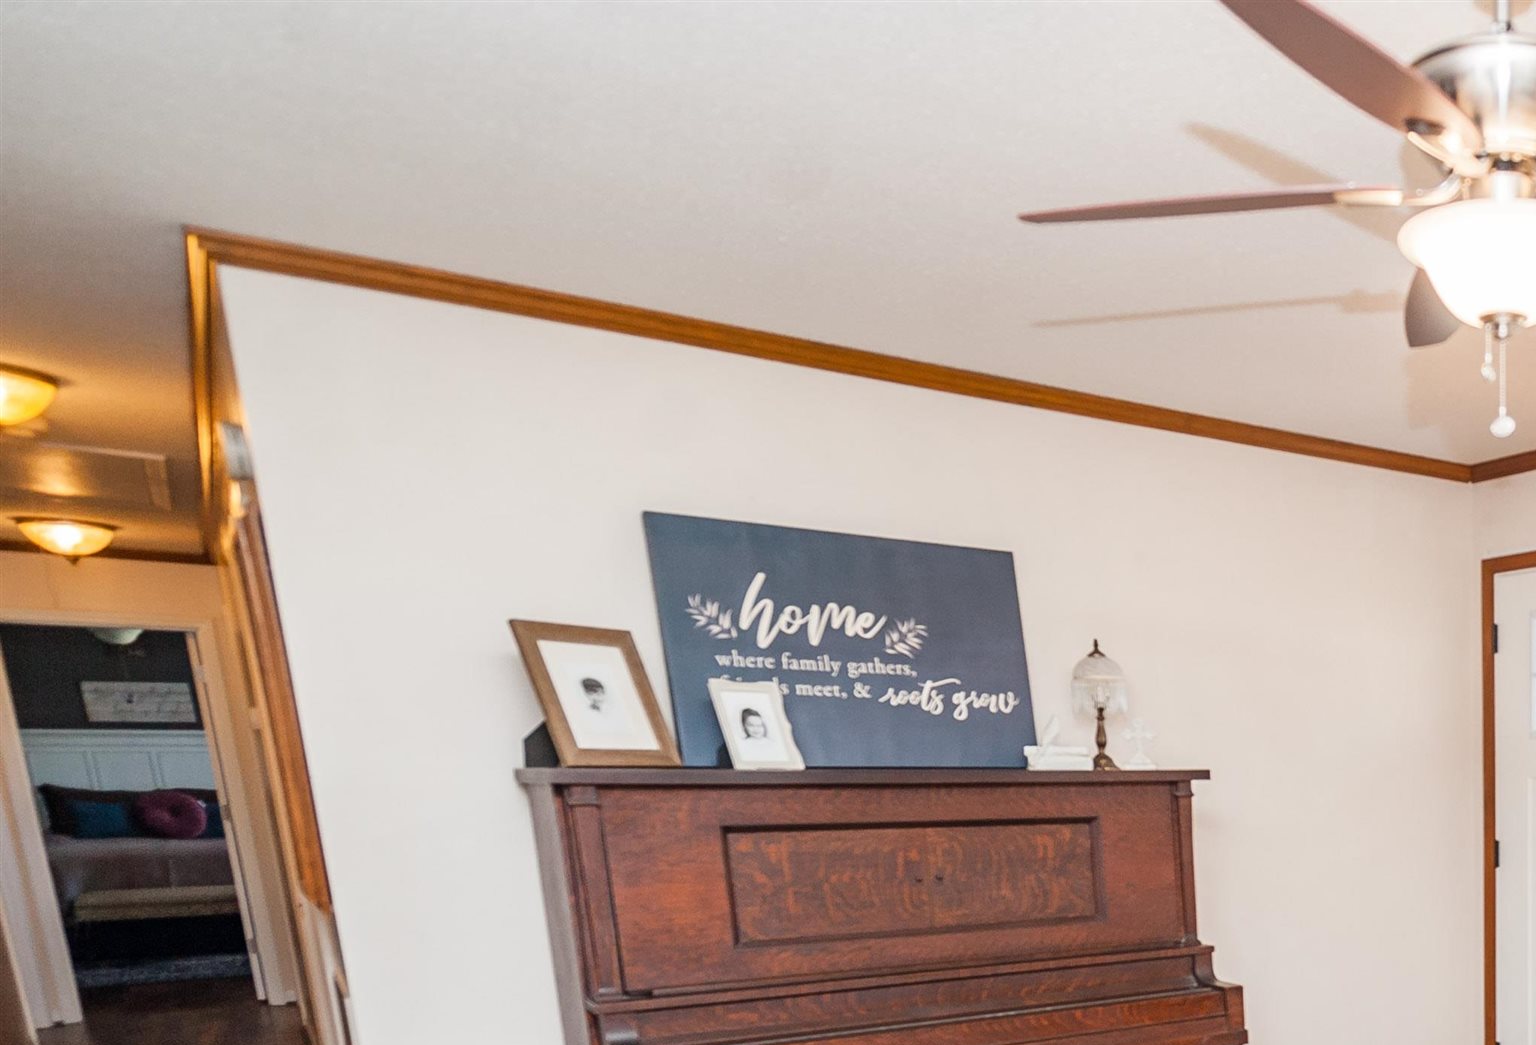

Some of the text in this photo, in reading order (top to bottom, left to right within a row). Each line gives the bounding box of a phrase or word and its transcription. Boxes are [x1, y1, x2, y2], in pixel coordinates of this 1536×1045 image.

[738, 571, 888, 649] home
[714, 648, 918, 678] where family gathers,
[795, 682, 848, 699] meet,
[853, 681, 872, 699] &
[878, 677, 961, 716] roots
[952, 687, 1020, 721] grow
